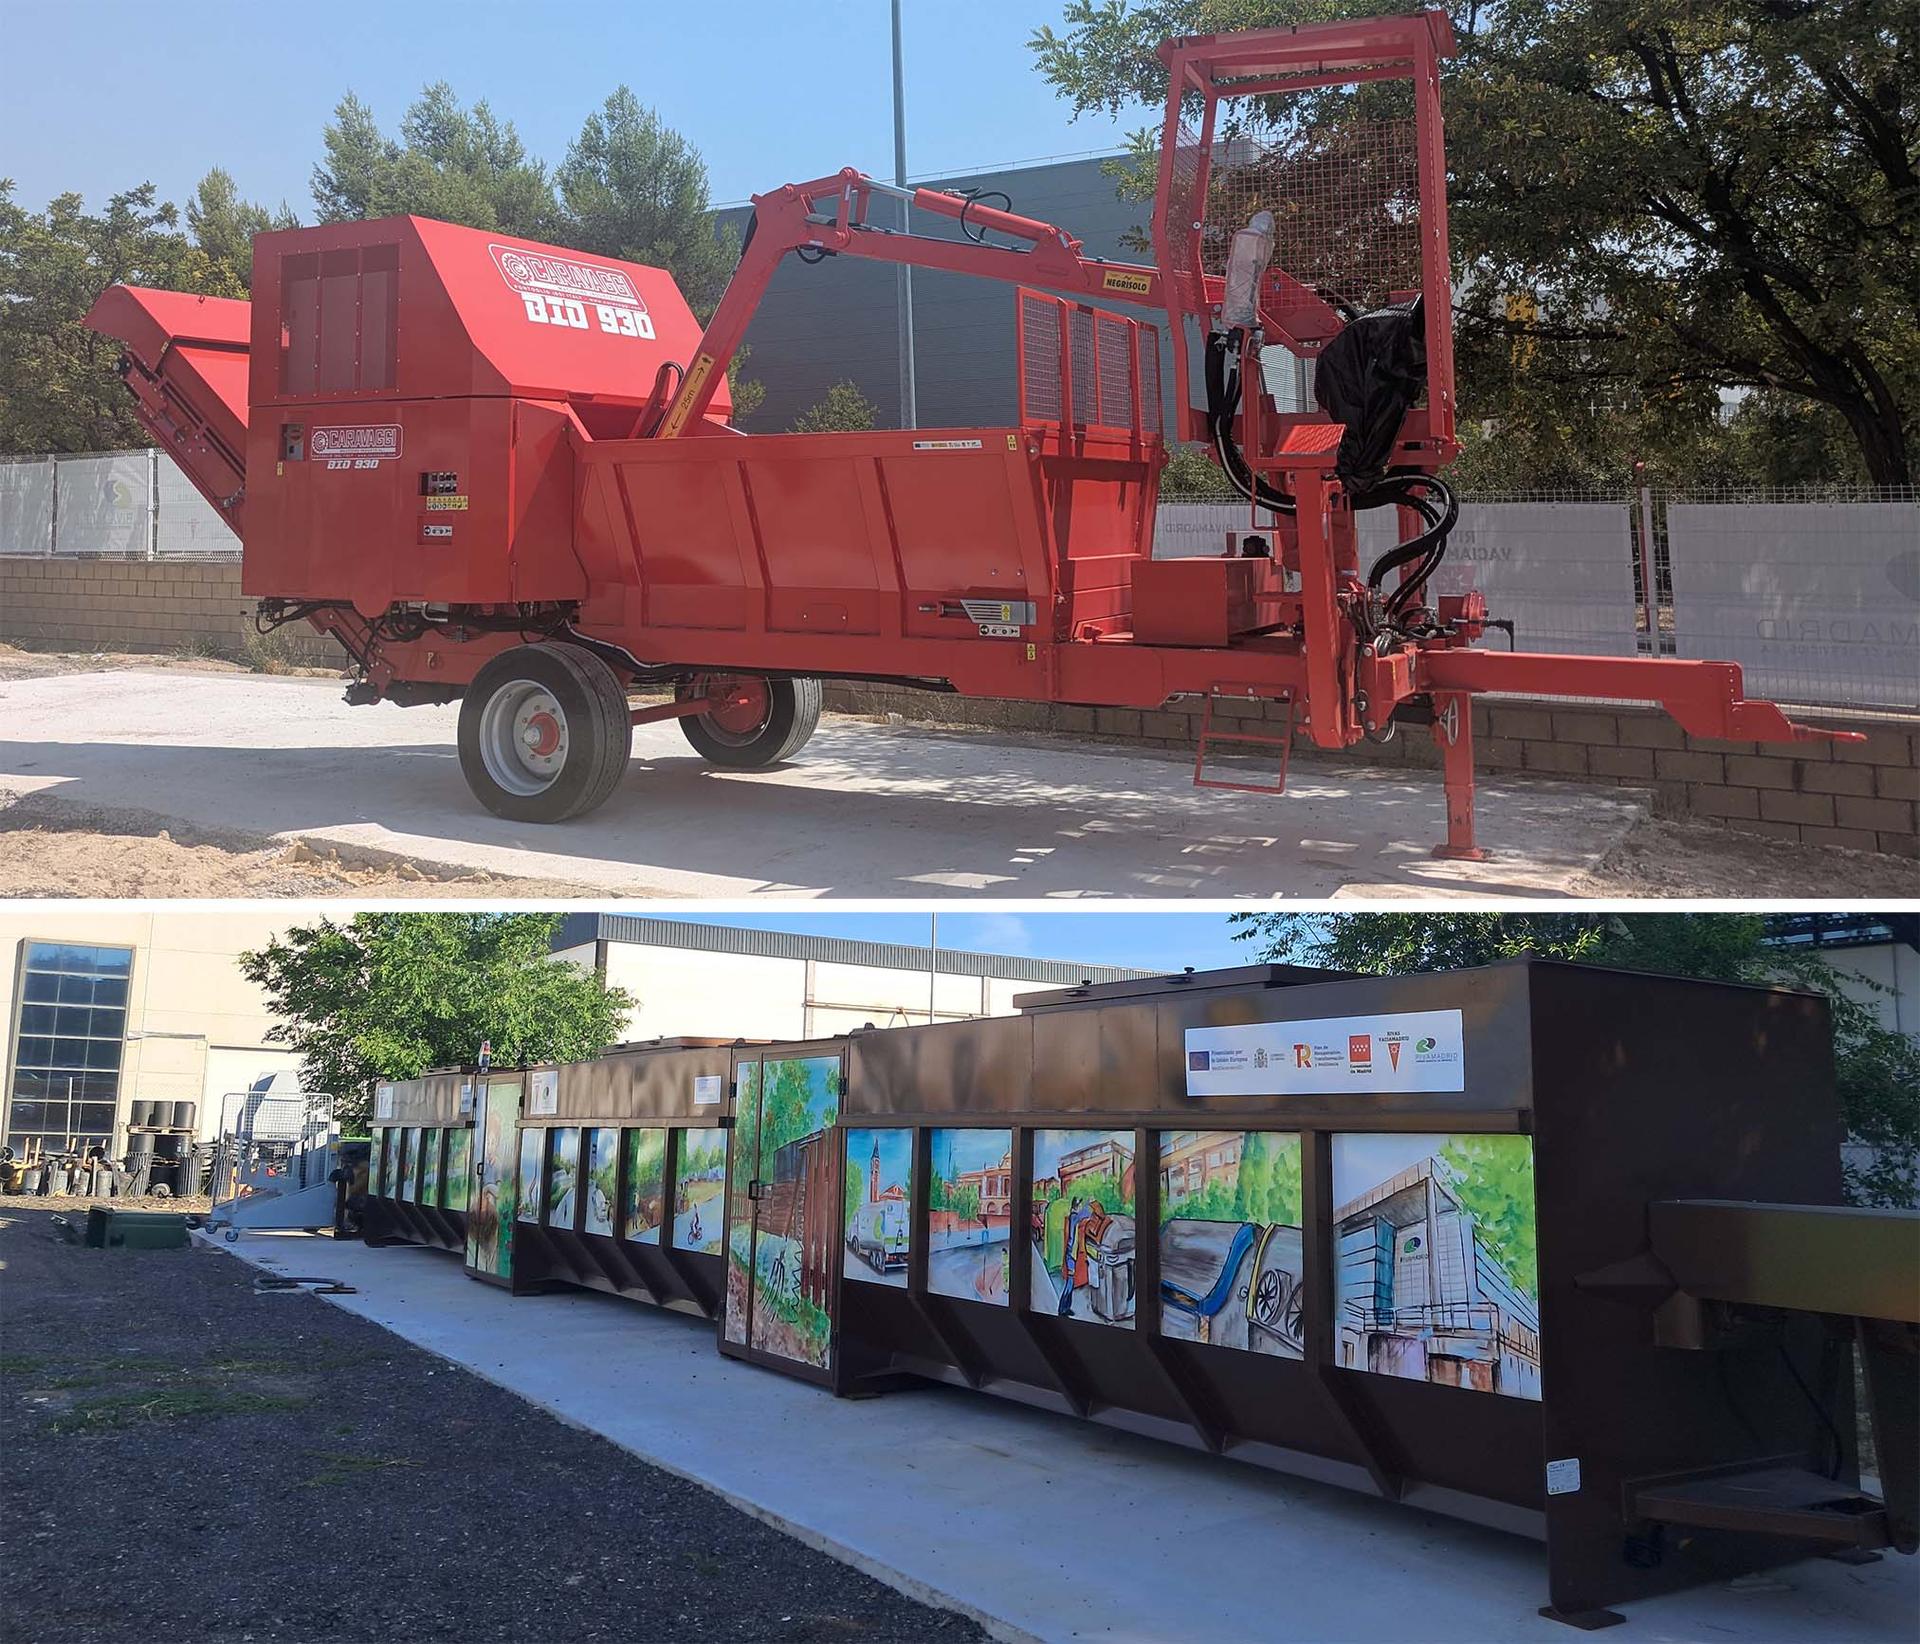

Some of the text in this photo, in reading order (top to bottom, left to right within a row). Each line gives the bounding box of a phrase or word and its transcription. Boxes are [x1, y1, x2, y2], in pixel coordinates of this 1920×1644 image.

[526, 256, 635, 298] CARAVAGGI
[1106, 278, 1147, 292] NEGRISOLO
[597, 305, 656, 340] 930
[329, 428, 396, 448] CARAVAGGI
[354, 459, 380, 470] 930
